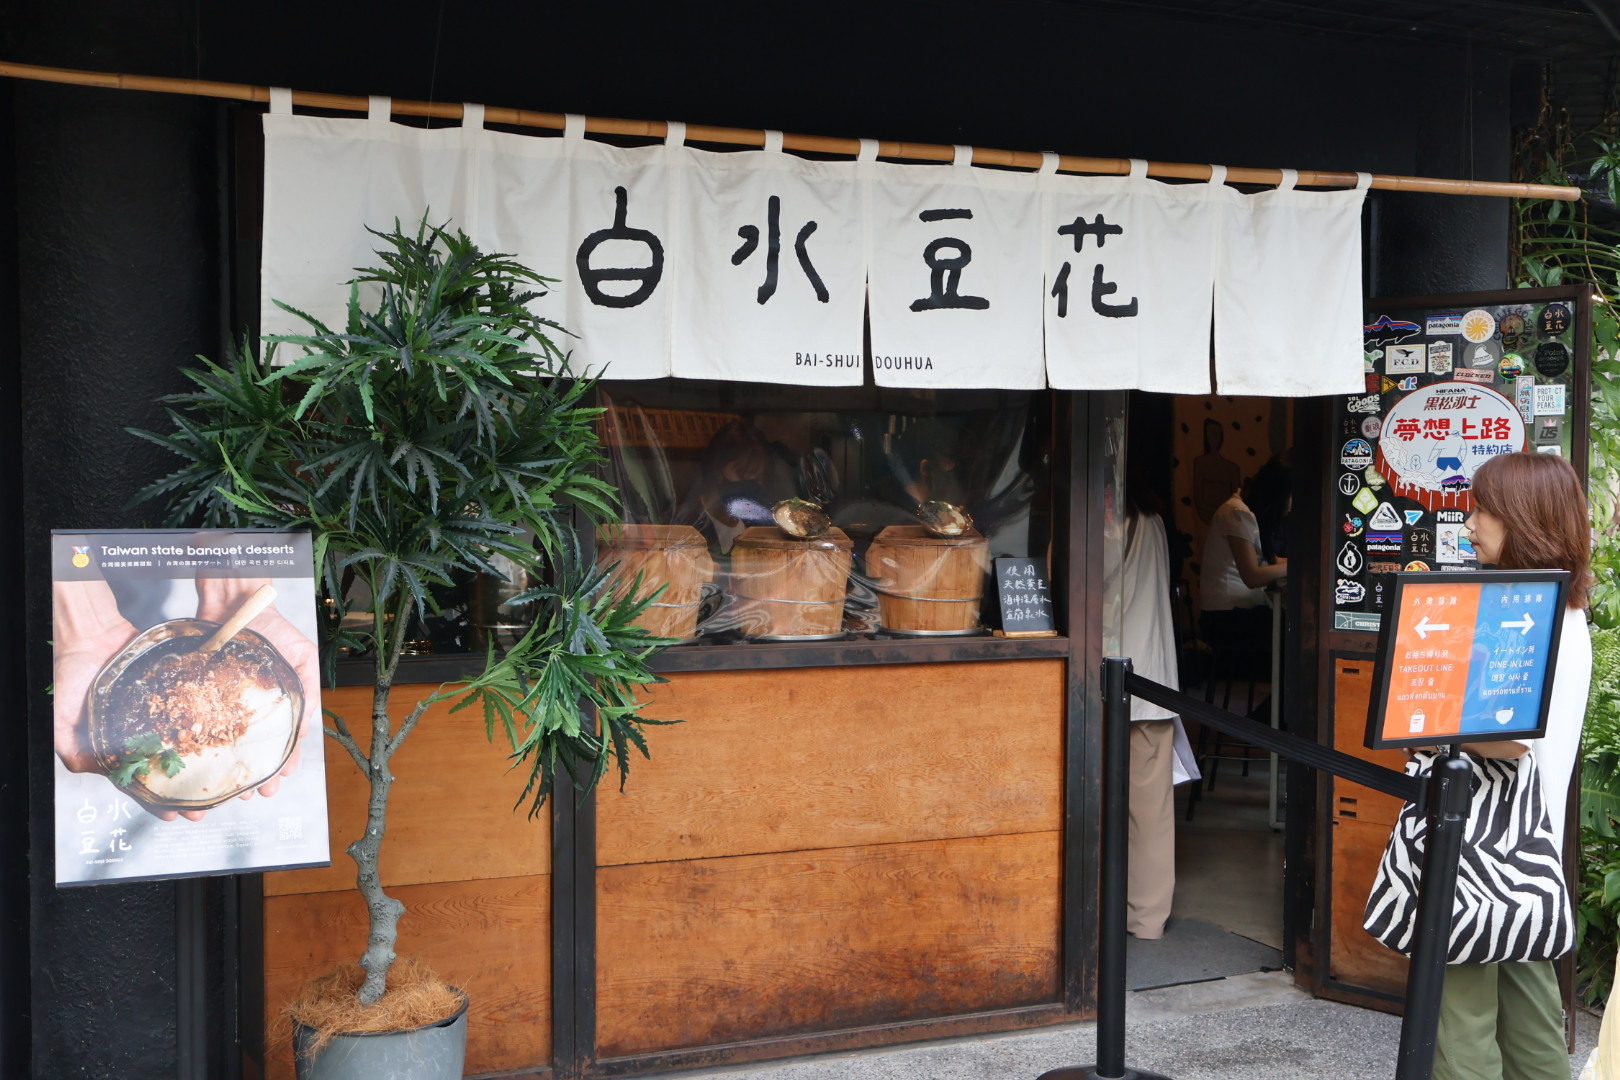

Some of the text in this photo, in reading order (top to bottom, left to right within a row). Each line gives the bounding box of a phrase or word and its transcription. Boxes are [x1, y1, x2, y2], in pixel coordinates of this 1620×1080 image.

[576, 185, 1138, 318] 白水豆花
[795, 352, 933, 370] BAI-SHUI DOUHUA
[1423, 395, 1482, 411] 黑松沙士
[1537, 401, 1556, 409] PEAKS
[1393, 416, 1511, 442] 夢想上路
[1471, 444, 1513, 456] 特約店
[1436, 511, 1464, 522] MiiR
[1410, 531, 1430, 542] 白水
[101, 544, 294, 557] Taiwan state banquet desserts
[1410, 543, 1430, 553] 豆花
[1005, 564, 1035, 577] 使用
[1493, 645, 1535, 656] イートイン列
[1399, 663, 1454, 673] TAKEOUT LINE
[1518, 659, 1534, 668] LINE
[77, 798, 132, 824] 白水
[78, 828, 132, 855] 豆花
